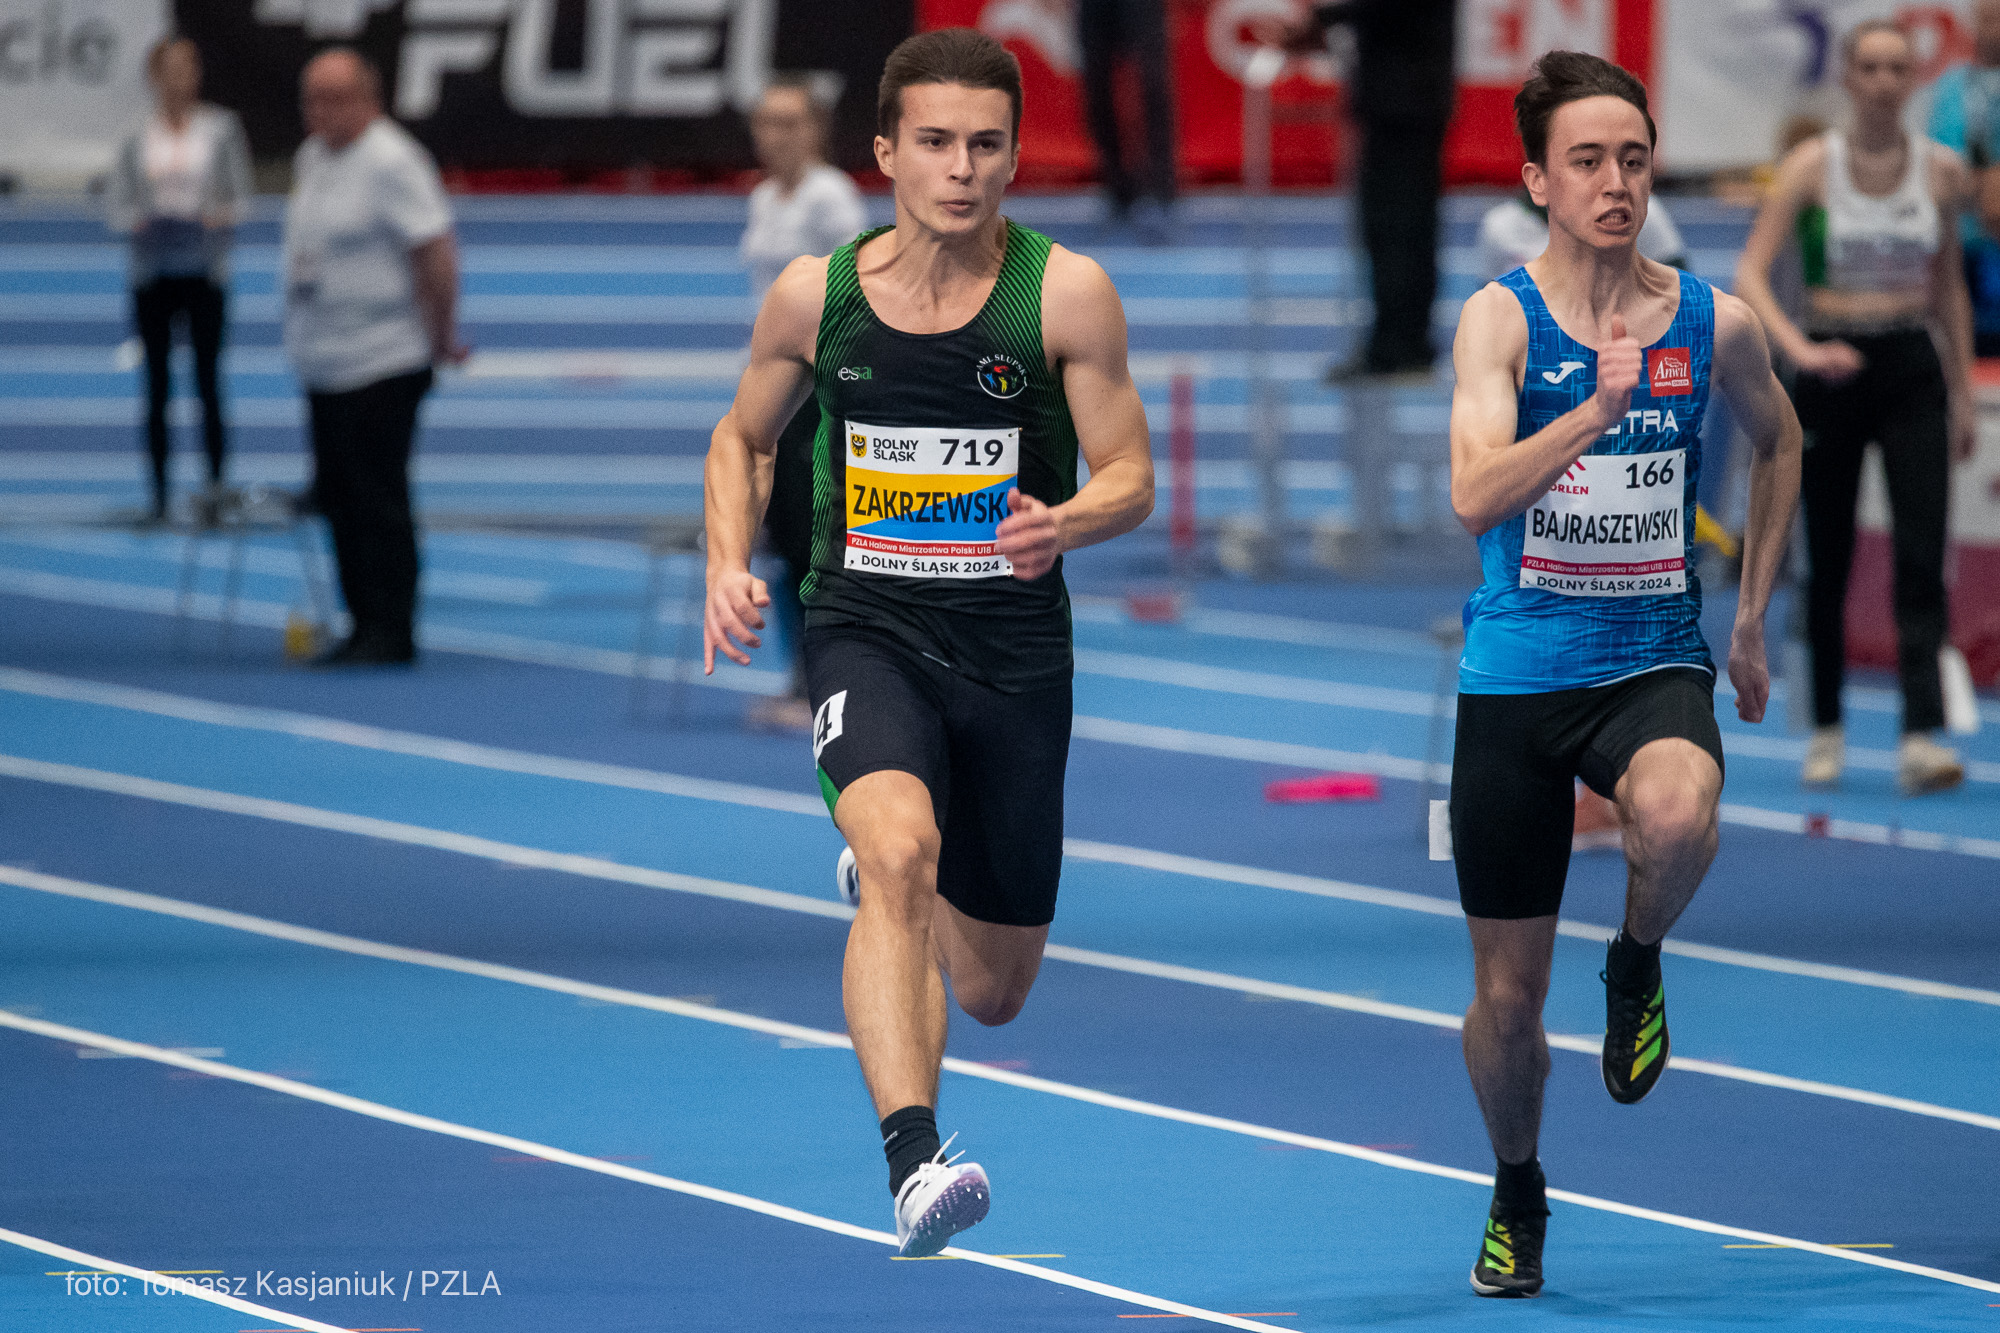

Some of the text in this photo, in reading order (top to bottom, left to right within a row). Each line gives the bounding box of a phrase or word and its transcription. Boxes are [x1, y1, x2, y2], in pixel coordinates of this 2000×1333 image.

[1654, 360, 1687, 380] Anwil
[1605, 409, 1679, 434] TRA
[872, 437, 1004, 466] DOLNY 719
[873, 447, 916, 463] ŚLĄSK
[1625, 458, 1674, 489] 166
[1550, 483, 1589, 495] ORLEN
[1532, 508, 1678, 545] BAJRASZEWSKI
[851, 537, 868, 546] PZLA
[868, 541, 898, 552] Halowe
[899, 544, 949, 554] Mistrzostwa
[950, 546, 976, 555] Polski
[977, 546, 991, 554] U18
[861, 554, 999, 575] DOLNY ŚLĄSK 2024
[1526, 558, 1546, 569] PZLA
[1546, 562, 1577, 573] Halowe
[1578, 565, 1627, 574] Mistrzostwa
[1628, 564, 1650, 574] Polski
[1650, 562, 1663, 571] U18
[1537, 575, 1671, 594] DOLNY ŚLĄSK 2024
[816, 701, 832, 750] 4
